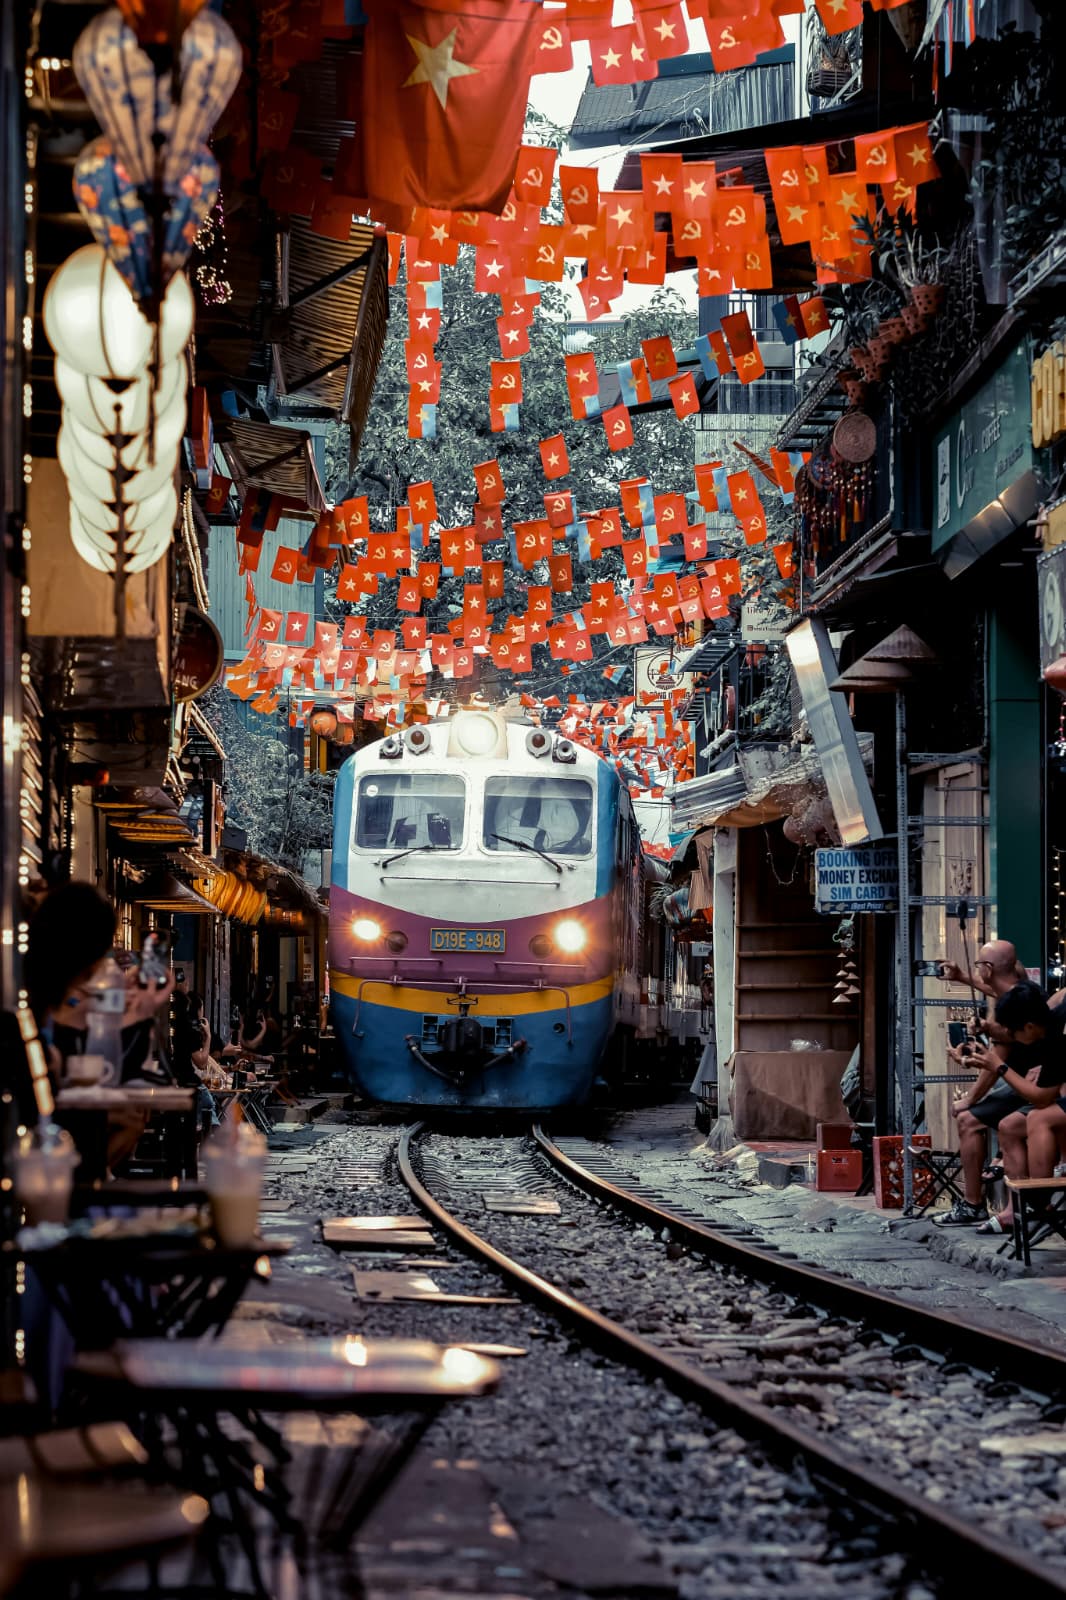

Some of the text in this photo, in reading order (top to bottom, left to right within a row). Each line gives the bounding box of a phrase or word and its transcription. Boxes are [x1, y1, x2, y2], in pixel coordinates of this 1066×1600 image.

[819, 852, 870, 867] BOOKING
[819, 869, 855, 884] MONEY
[831, 886, 852, 900] SIM
[856, 886, 885, 899] CARD
[434, 931, 501, 948] D19E-948
